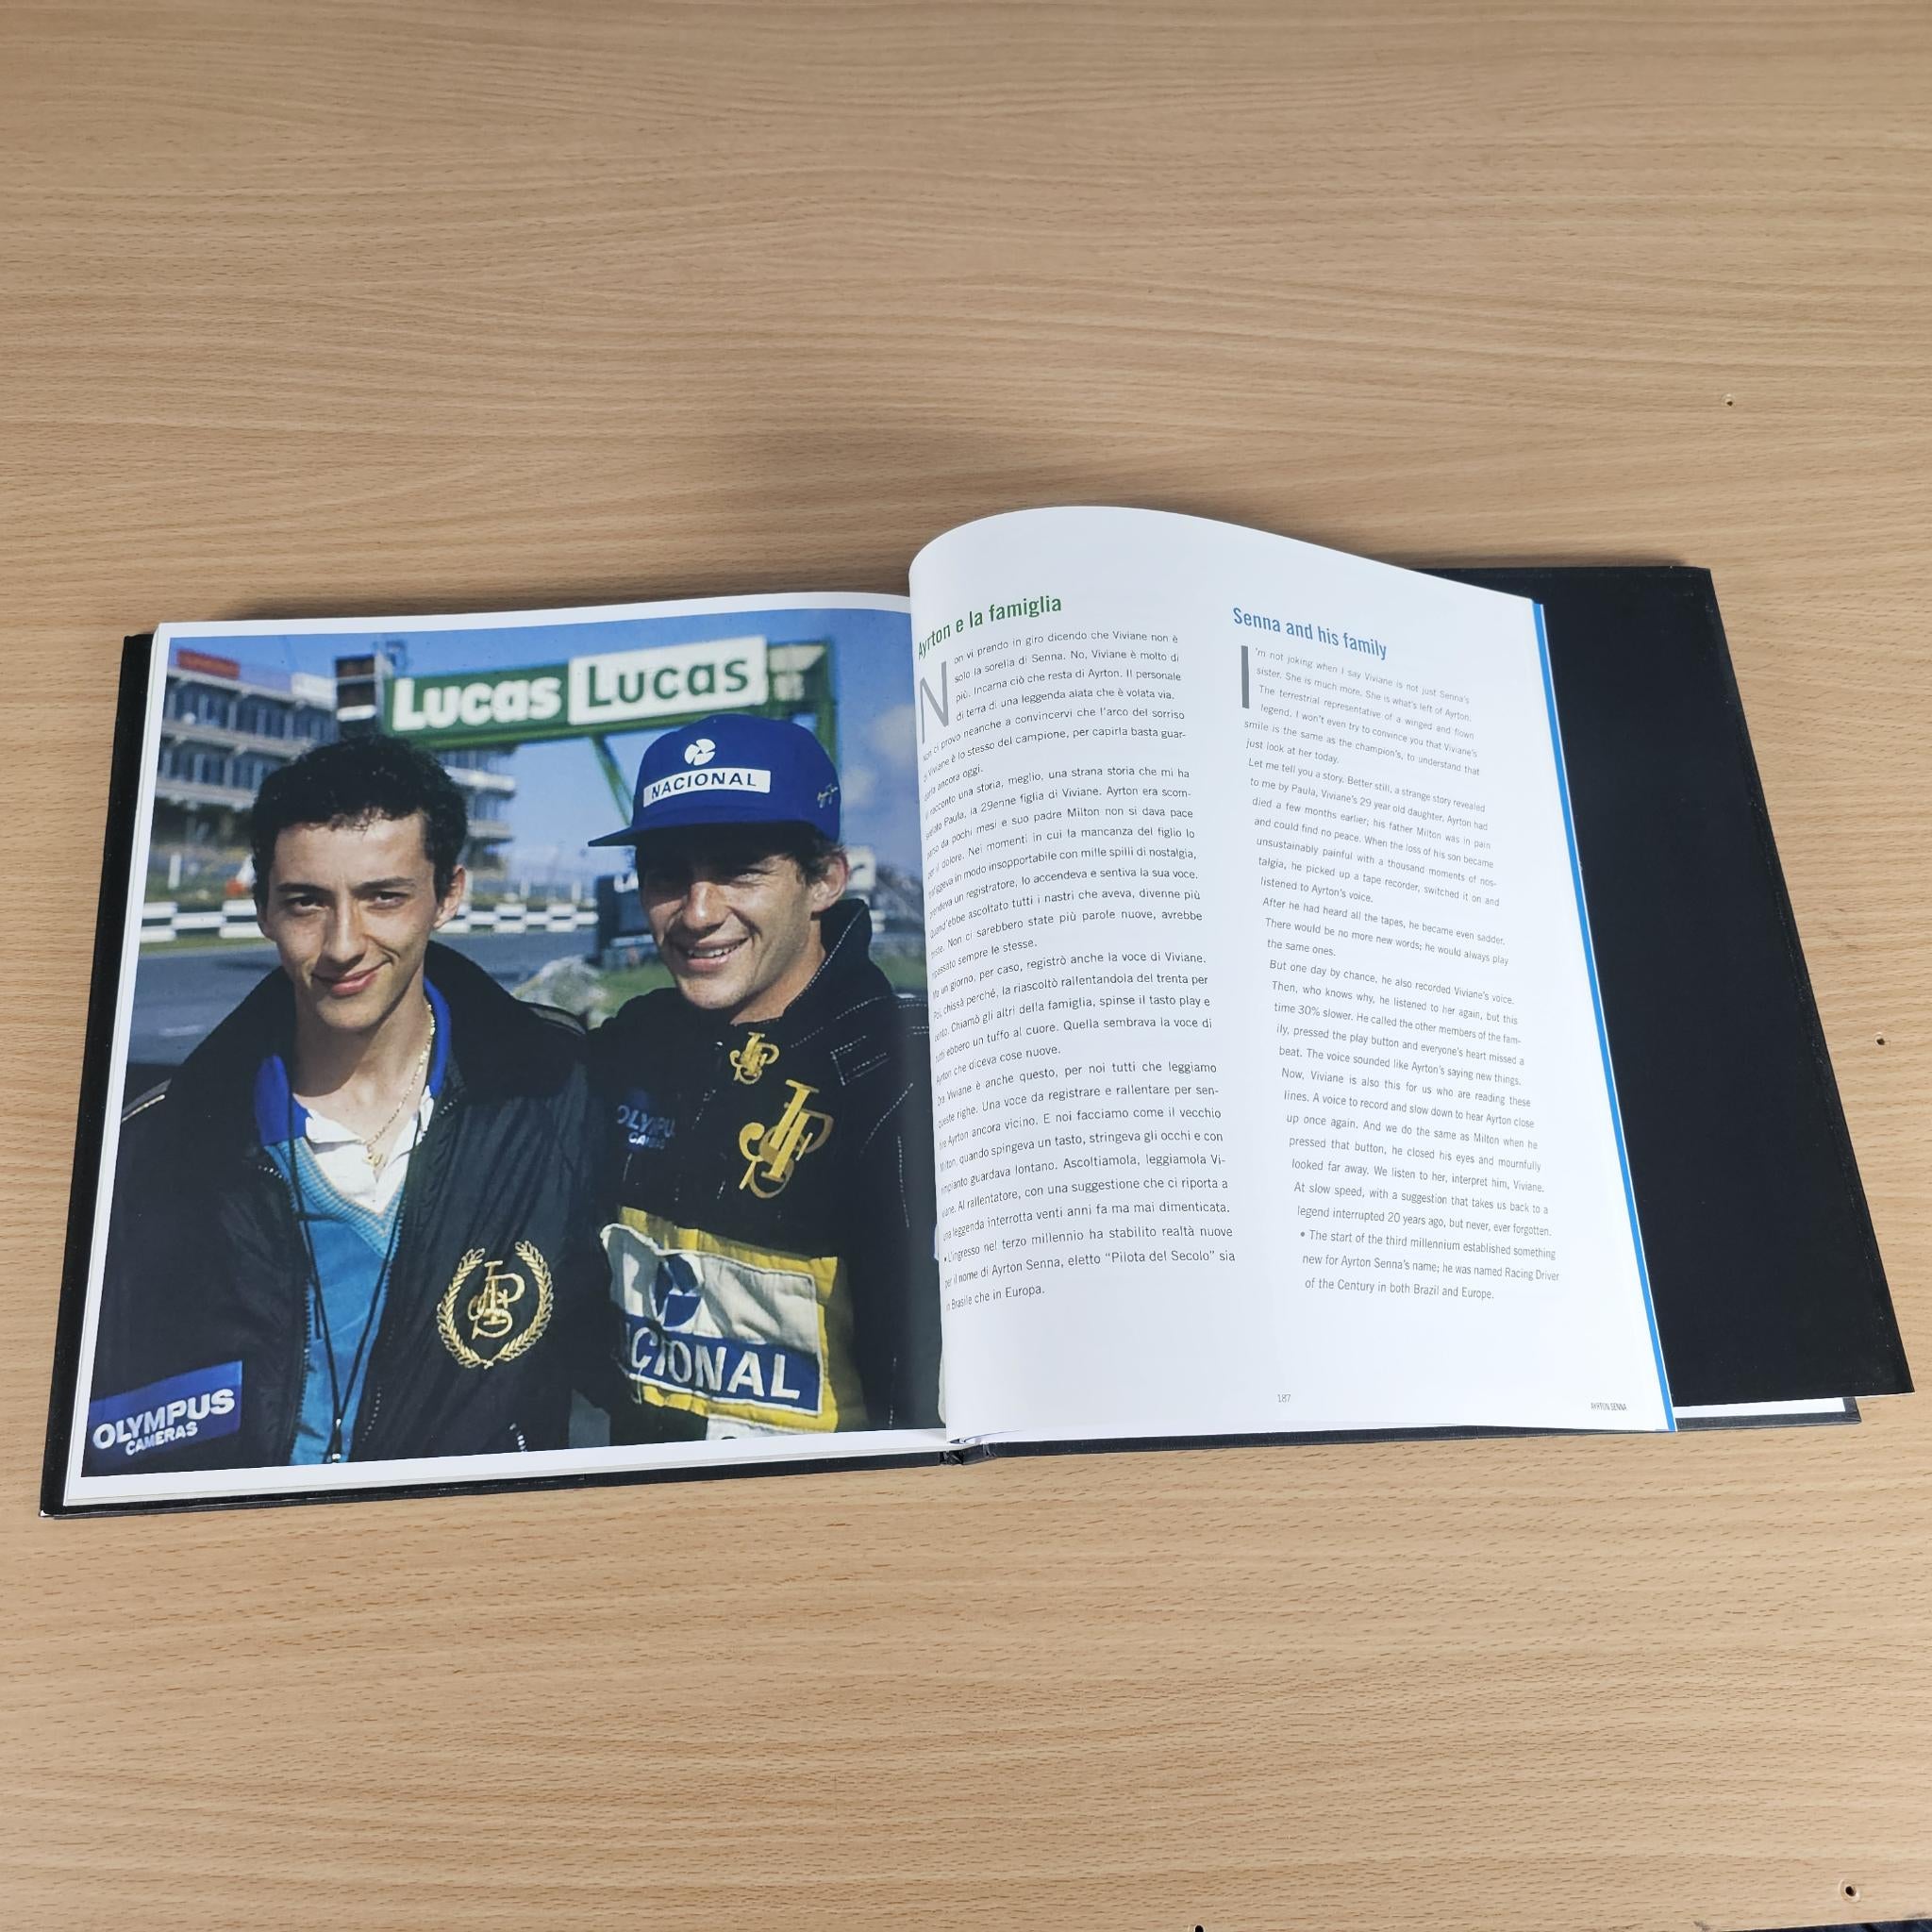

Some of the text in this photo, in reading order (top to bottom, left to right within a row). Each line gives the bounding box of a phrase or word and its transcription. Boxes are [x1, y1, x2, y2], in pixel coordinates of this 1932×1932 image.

[918, 595, 1062, 660] Ayrton e la famiglia
[1232, 607, 1387, 660] Senna and his family
[588, 659, 748, 708] Lucas
[956, 668, 1181, 704] più. Incarna ciò che resta di Ayrton. Il personale
[392, 676, 563, 732] Lucas
[1258, 684, 1274, 695] The
[1279, 689, 1320, 705] terrestrial
[1324, 700, 1380, 718] representative
[1404, 719, 1432, 730] winged
[1436, 725, 1450, 734] and
[651, 772, 757, 800] NACIONAL
[954, 846, 1196, 883] in modo insopportabile con mille spilli di nostalgia,
[1256, 838, 1319, 856] unsustainably
[1322, 848, 1352, 859] painful
[1357, 854, 1374, 864] with
[1387, 858, 1424, 874] thousand
[1428, 868, 1465, 881] moments
[1468, 874, 1475, 883] of
[968, 901, 1008, 919] ascoltato
[1011, 894, 1032, 908] tutti
[1044, 890, 1074, 903] nastri
[1077, 890, 1097, 899] che
[1101, 890, 1134, 898] aveva,
[1139, 888, 1180, 898] divenne
[1184, 890, 1200, 901] più
[1260, 875, 1297, 890] listened
[1300, 883, 1308, 891] to
[1348, 891, 1373, 903] voice.
[941, 985, 948, 994] un
[950, 974, 975, 991] giorno,
[979, 968, 993, 981] per
[996, 963, 1023, 974] caso,
[1026, 955, 1066, 970] registrò
[1070, 953, 1104, 963] anche
[1108, 952, 1117, 961] la
[1121, 953, 1146, 961] voce
[1150, 951, 1160, 961] di
[1164, 951, 1206, 962] Viviane.
[1269, 958, 1287, 970] But
[1290, 964, 1307, 973] one
[1310, 965, 1326, 977] day
[1329, 967, 1341, 979] by
[1342, 970, 1377, 984] chance,
[1381, 974, 1391, 985] he
[1394, 977, 1411, 988] also
[1414, 982, 1450, 994] recorded
[1491, 994, 1514, 1004] voice.
[953, 1064, 966, 1075] che
[968, 1056, 996, 1070] diceva
[999, 1051, 1022, 1061] cose
[1025, 1046, 1060, 1057] nuove.
[1278, 1045, 1302, 1057] beat.
[1306, 1047, 1324, 1059] The
[1326, 1051, 1350, 1062] voice
[1353, 1056, 1390, 1069] sounded
[1393, 1058, 1408, 1070] like
[1447, 1068, 1474, 1080] saying
[1475, 1072, 1491, 1081] new
[1494, 1073, 1521, 1086] things.
[1289, 1137, 1541, 1173] pressed that button, he closed his eyes and mournfully
[952, 1219, 984, 1237] leggenda
[987, 1211, 1032, 1227] interrotta
[1036, 1207, 1062, 1220] venti
[1067, 1204, 1091, 1216] anni
[1095, 1203, 1107, 1214] fa
[1111, 1204, 1129, 1213] ma
[1133, 1201, 1155, 1212] mai
[1158, 1201, 1229, 1212] dimenticata.
[1297, 1205, 1551, 1236] legend interrupted 20 years ago, but never, ever forgotten.
[958, 1271, 977, 1283] nome
[980, 1265, 988, 1277] di
[991, 1262, 1022, 1277] Ayrton
[1025, 1258, 1063, 1270] Senna,
[1068, 1254, 1100, 1266] eletto
[1148, 1250, 1166, 1261] del
[1219, 1249, 1235, 1261] sia
[1305, 1277, 1493, 1301] of the Century in both Brazil and Europe.
[626, 1323, 800, 1399] CIONAL
[1277, 1393, 1291, 1404] 187
[92, 1389, 235, 1449] OLYMPUS
[125, 1422, 198, 1456] CAMERAS
